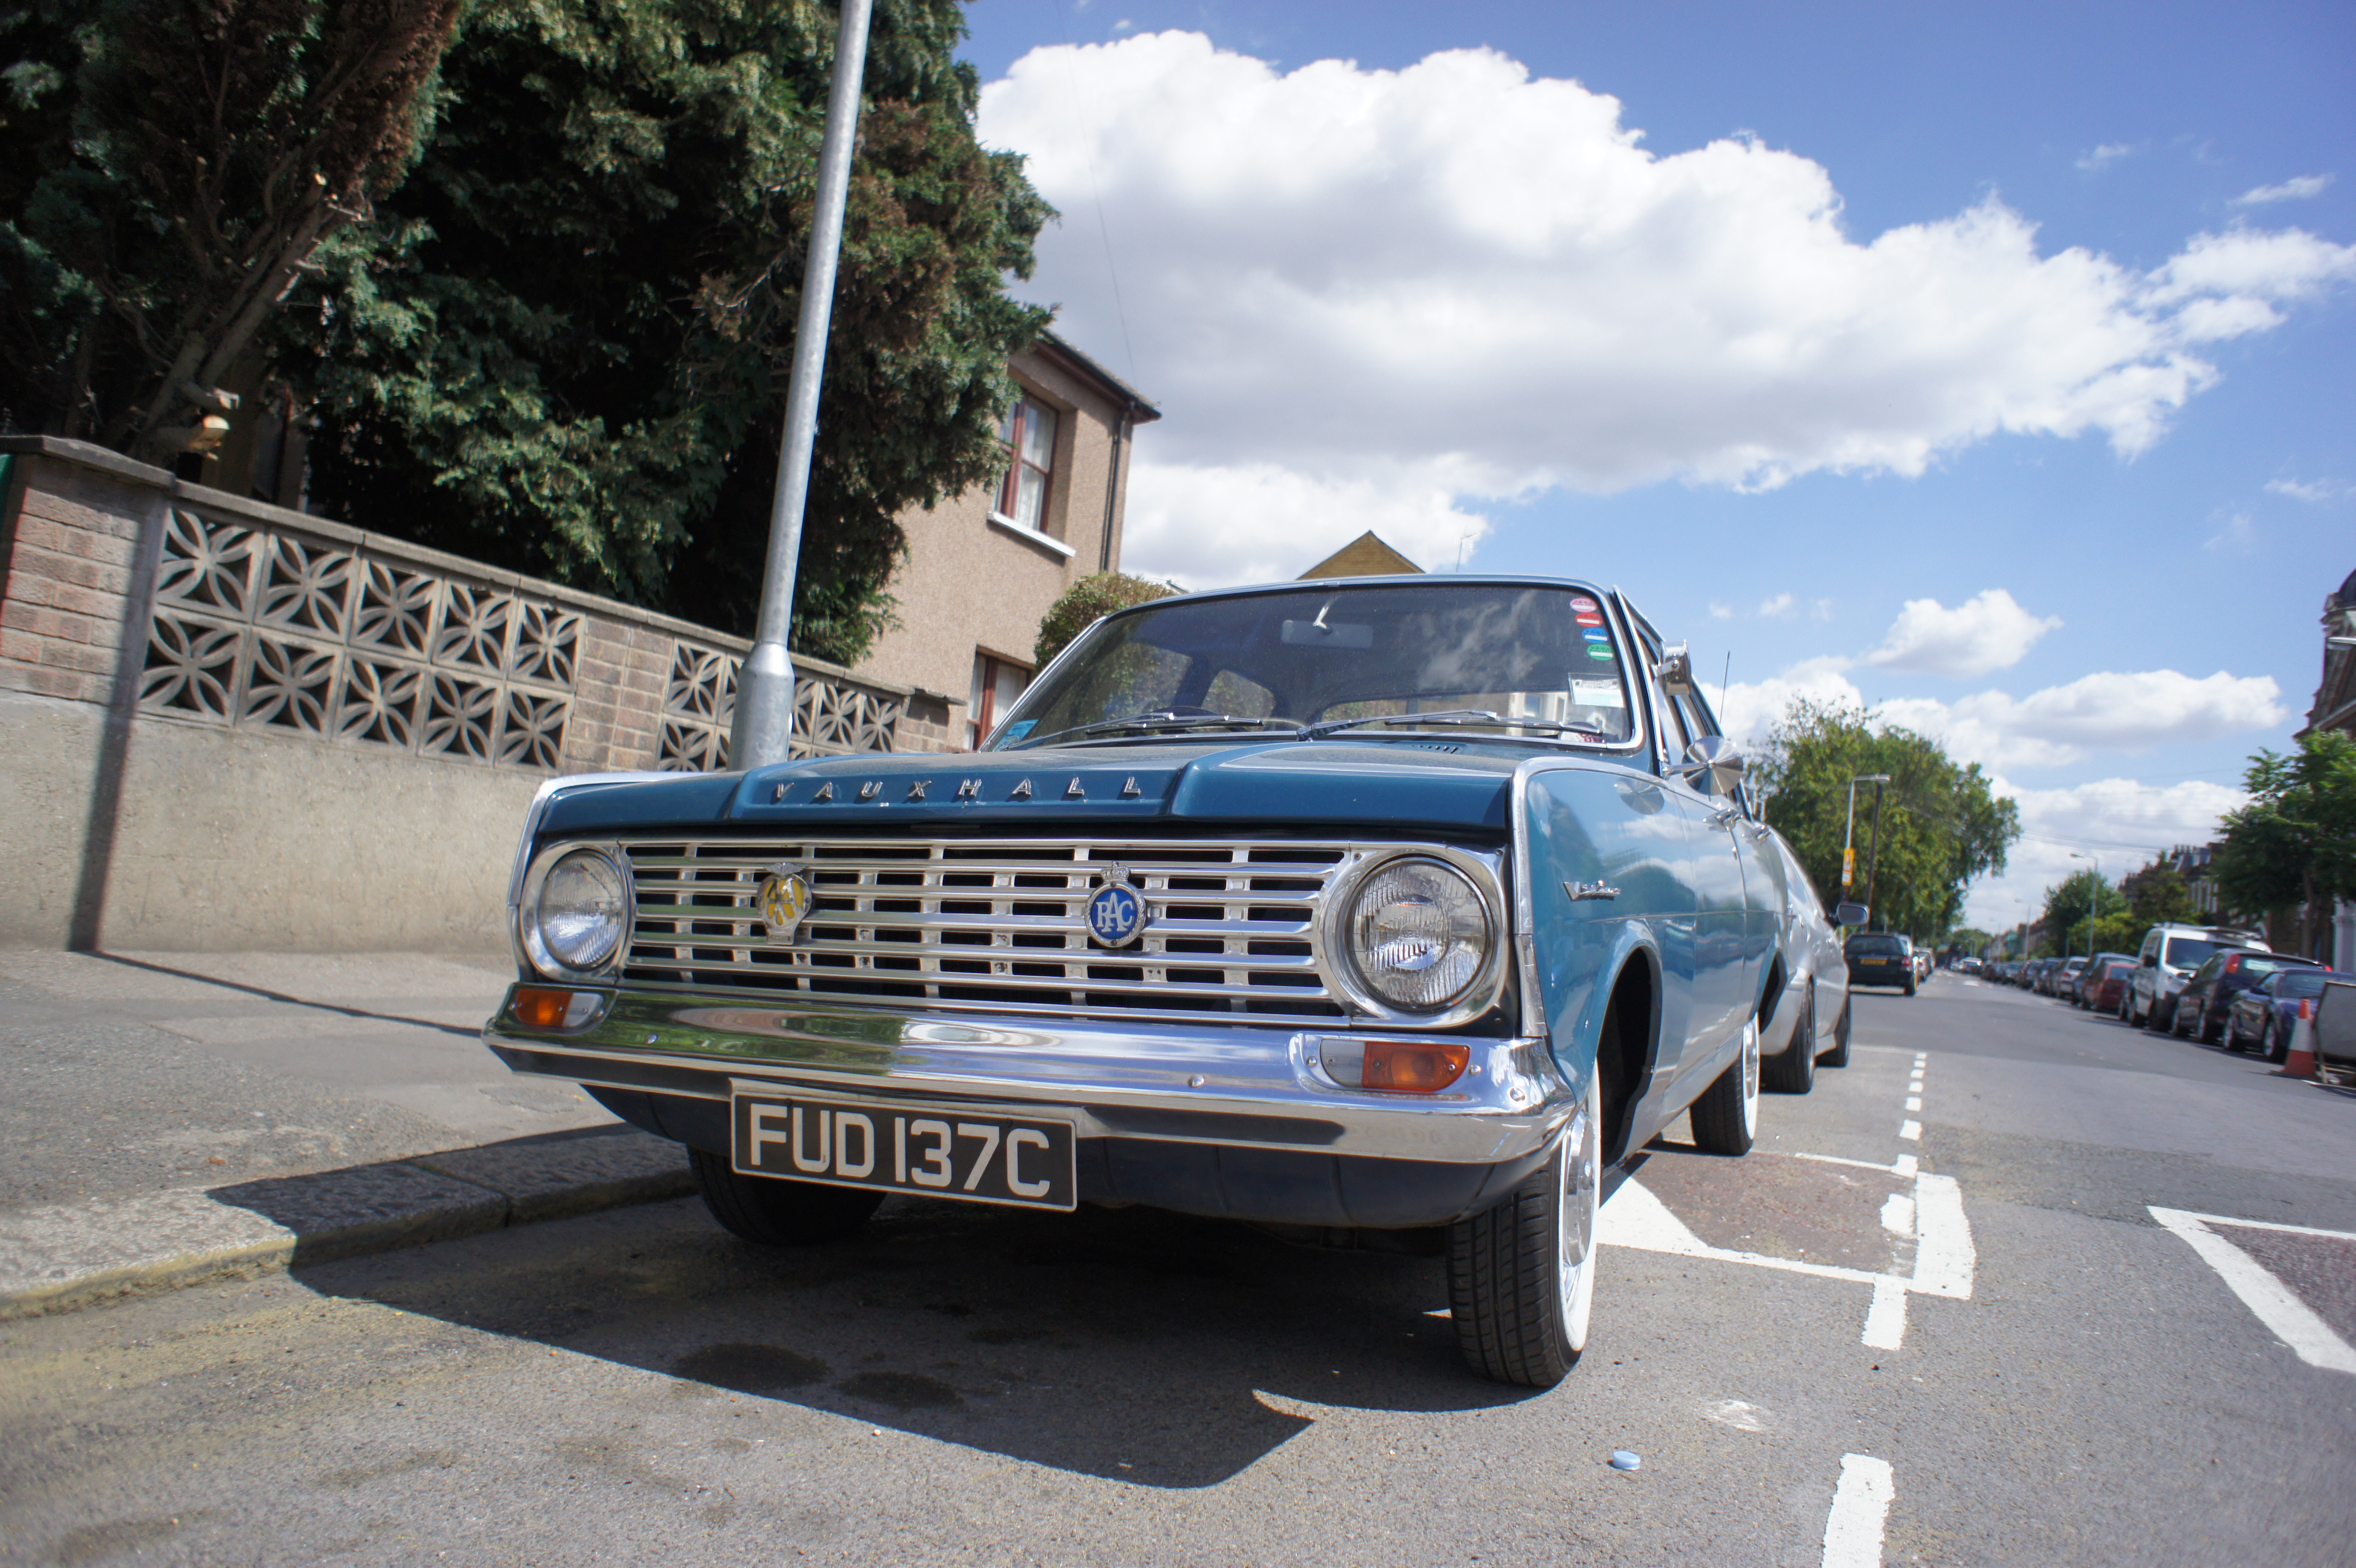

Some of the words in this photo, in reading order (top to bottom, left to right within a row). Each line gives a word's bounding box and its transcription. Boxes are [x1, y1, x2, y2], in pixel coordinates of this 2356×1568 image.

[775, 776, 1141, 800] VAUXHALL
[1095, 892, 1134, 932] RAC
[750, 1103, 875, 1178] FUD
[894, 1116, 1051, 1198] 137C
